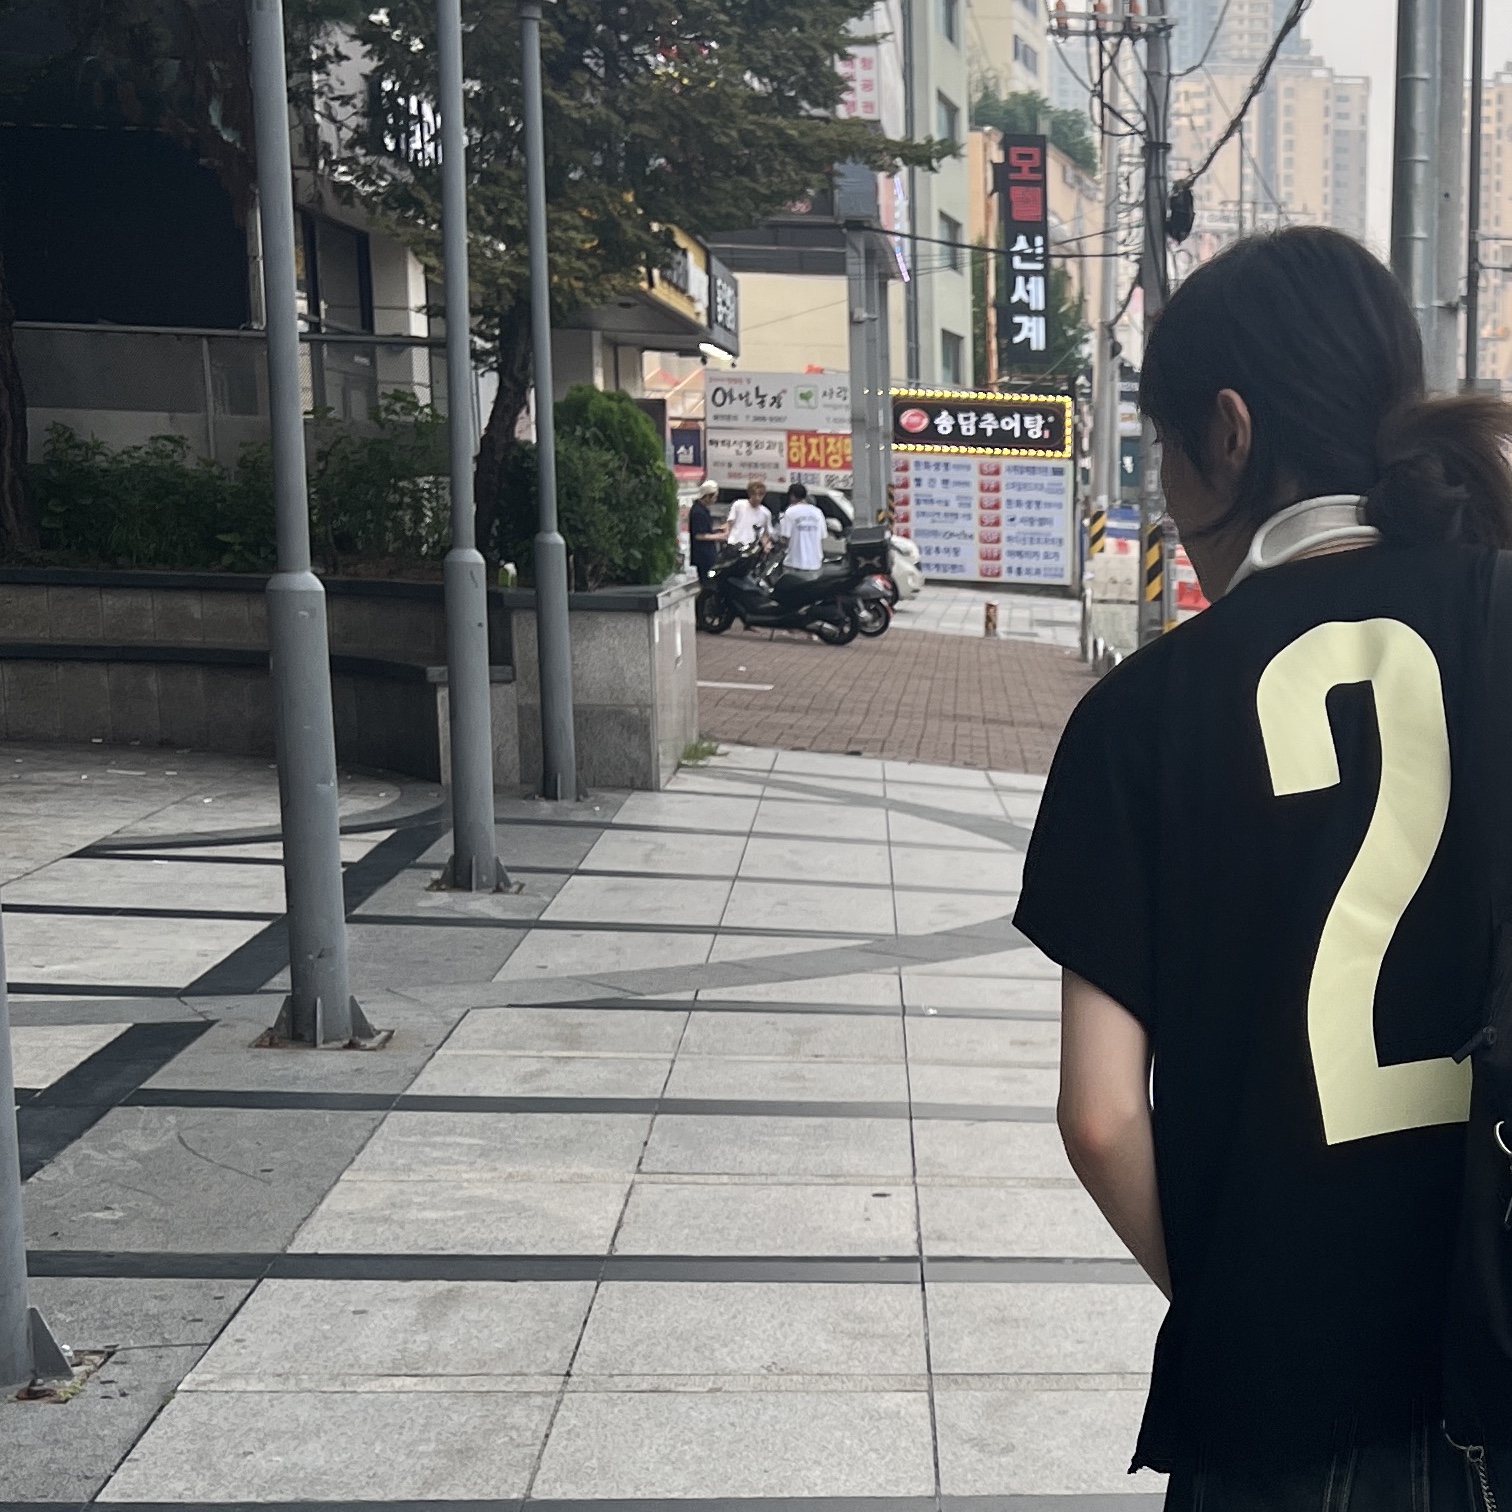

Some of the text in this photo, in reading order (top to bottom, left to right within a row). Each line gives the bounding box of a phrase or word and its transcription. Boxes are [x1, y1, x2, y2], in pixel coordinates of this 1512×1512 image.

[1010, 233, 1046, 352] 신세계
[933, 409, 1045, 439] 송담추어탕
[1256, 617, 1472, 1146] 2
